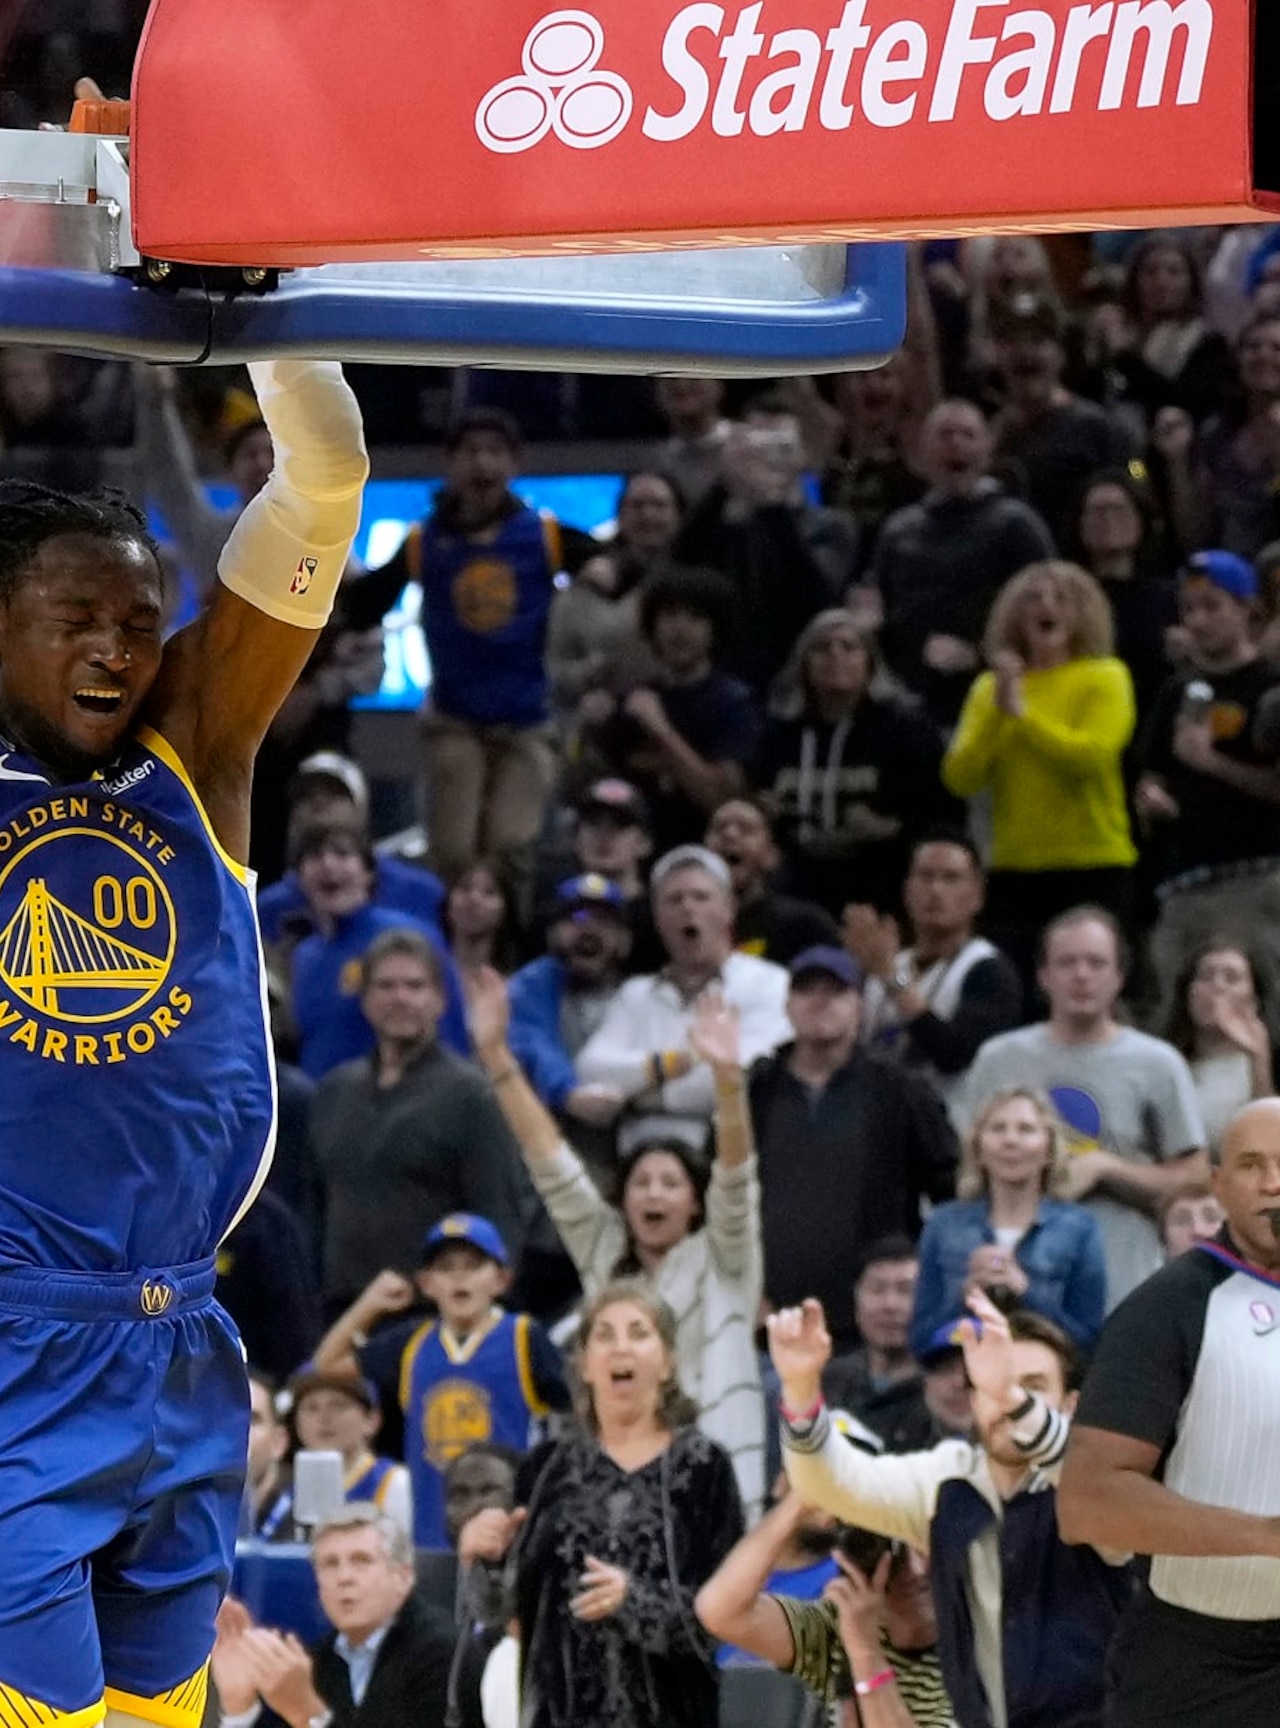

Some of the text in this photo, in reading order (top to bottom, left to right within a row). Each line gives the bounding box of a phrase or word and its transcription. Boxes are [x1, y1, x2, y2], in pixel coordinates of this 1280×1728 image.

[101, 759, 157, 795] kuten
[102, 803, 176, 866] STATE
[93, 875, 157, 929] 00
